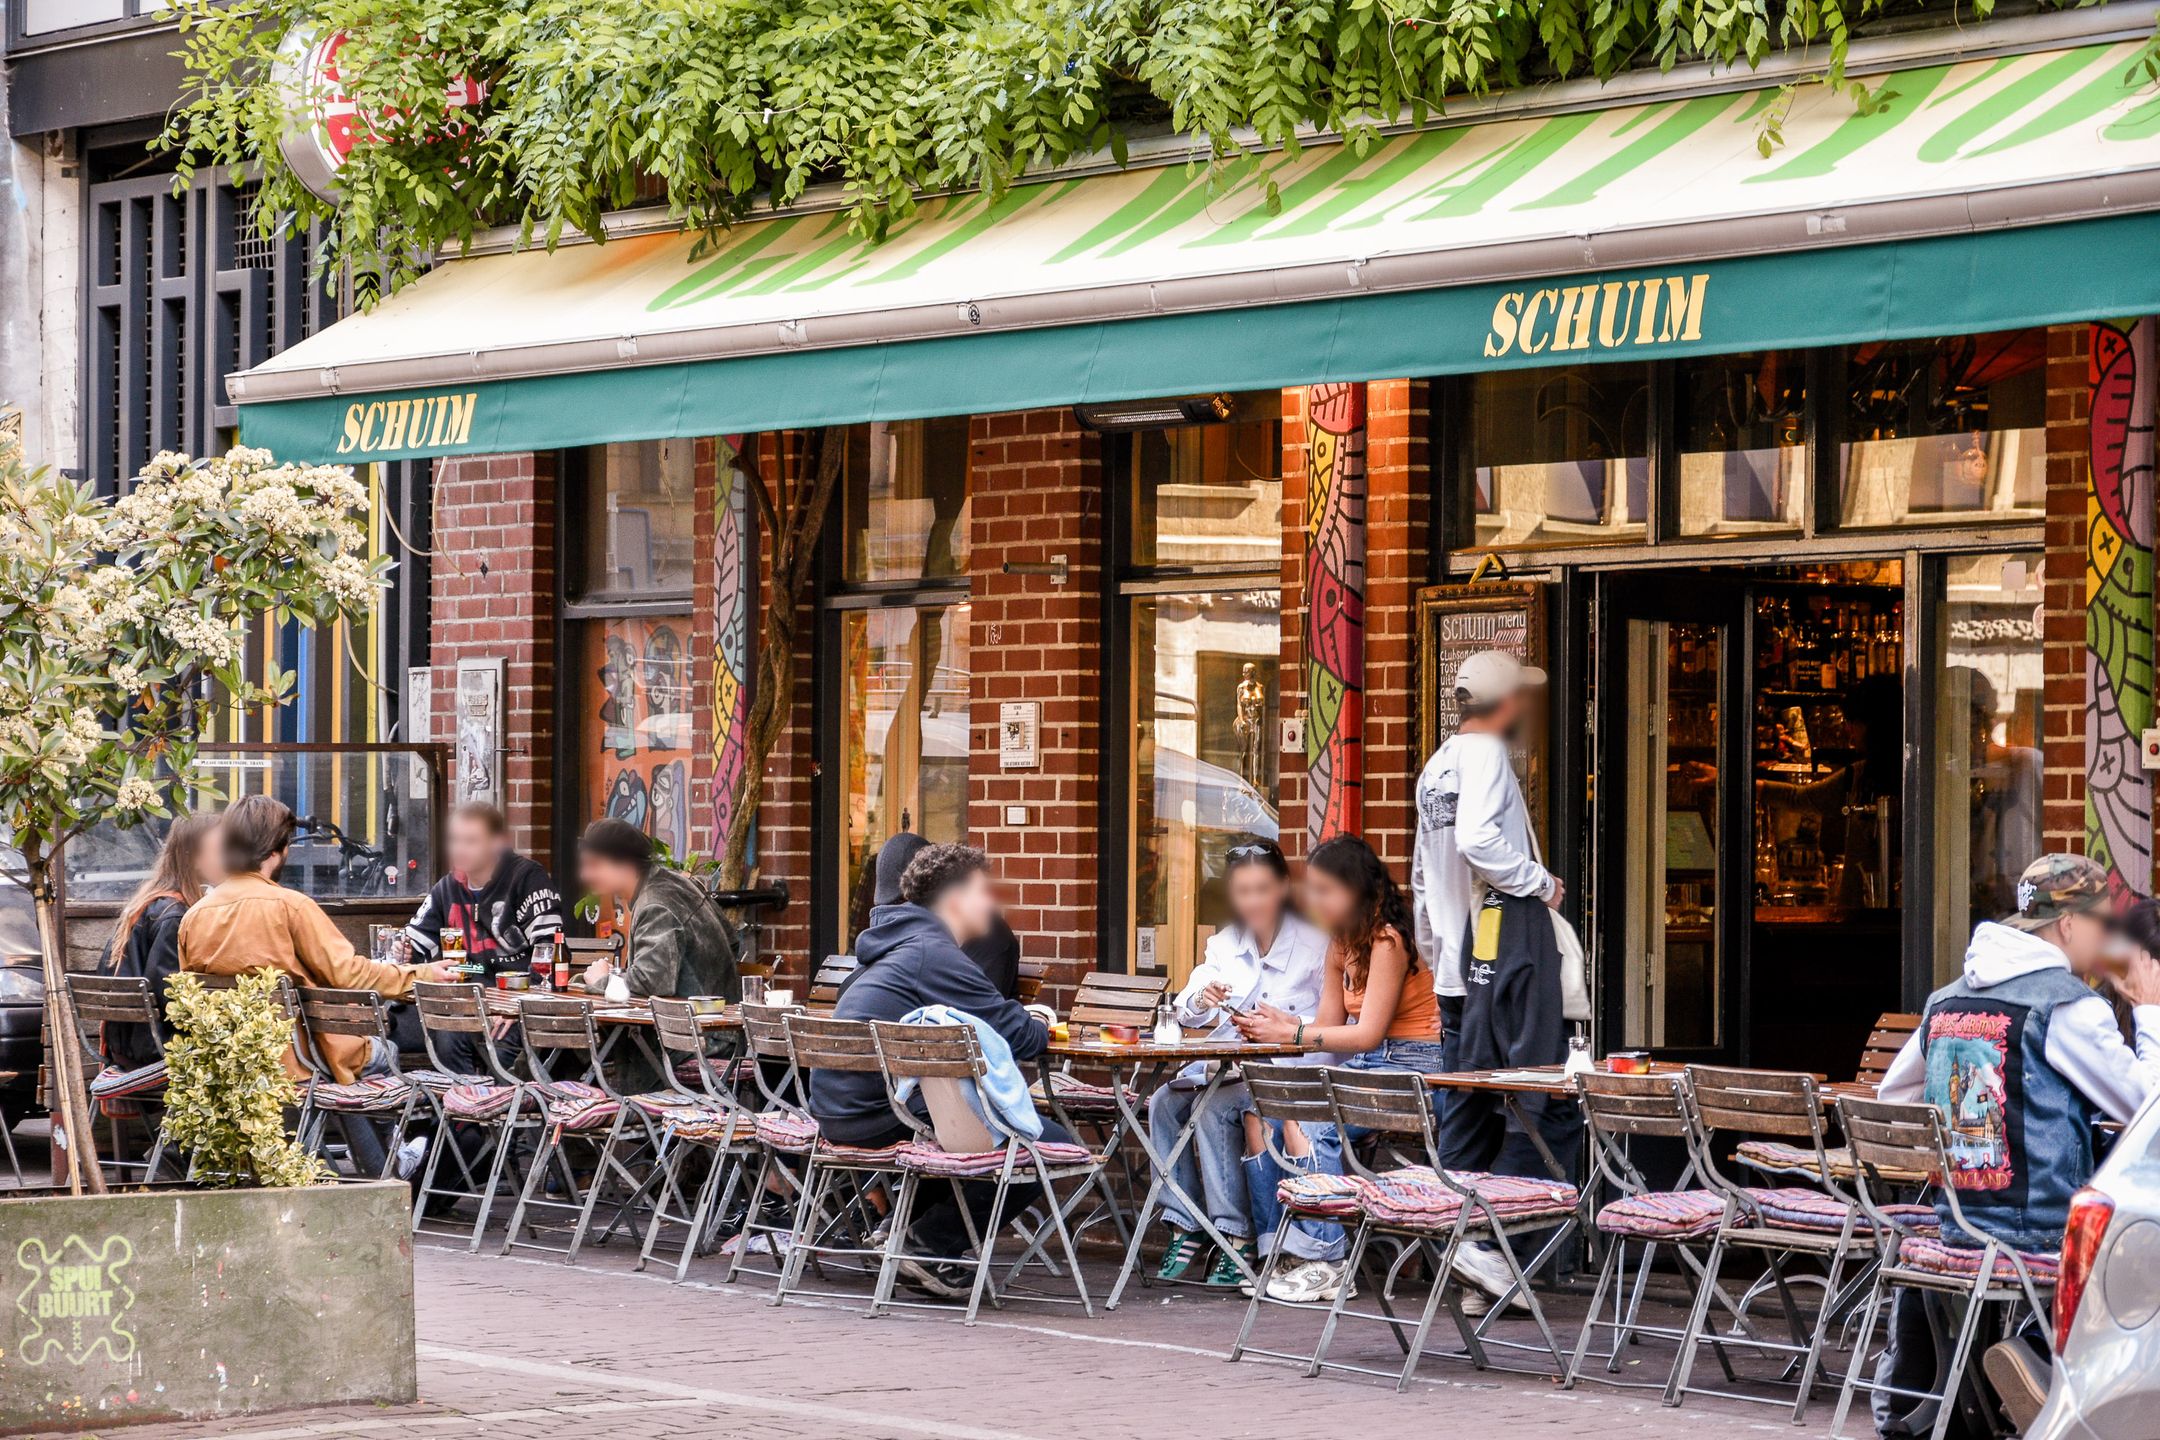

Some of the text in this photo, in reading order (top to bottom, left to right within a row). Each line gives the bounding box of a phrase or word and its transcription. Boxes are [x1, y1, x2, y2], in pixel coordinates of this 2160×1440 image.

[1484, 274, 1710, 357] SCHUIM
[336, 393, 477, 454] SCHUIM
[1498, 613, 1526, 629] menu
[49, 1265, 102, 1292] SPUI
[38, 1290, 114, 1318] BUURT
